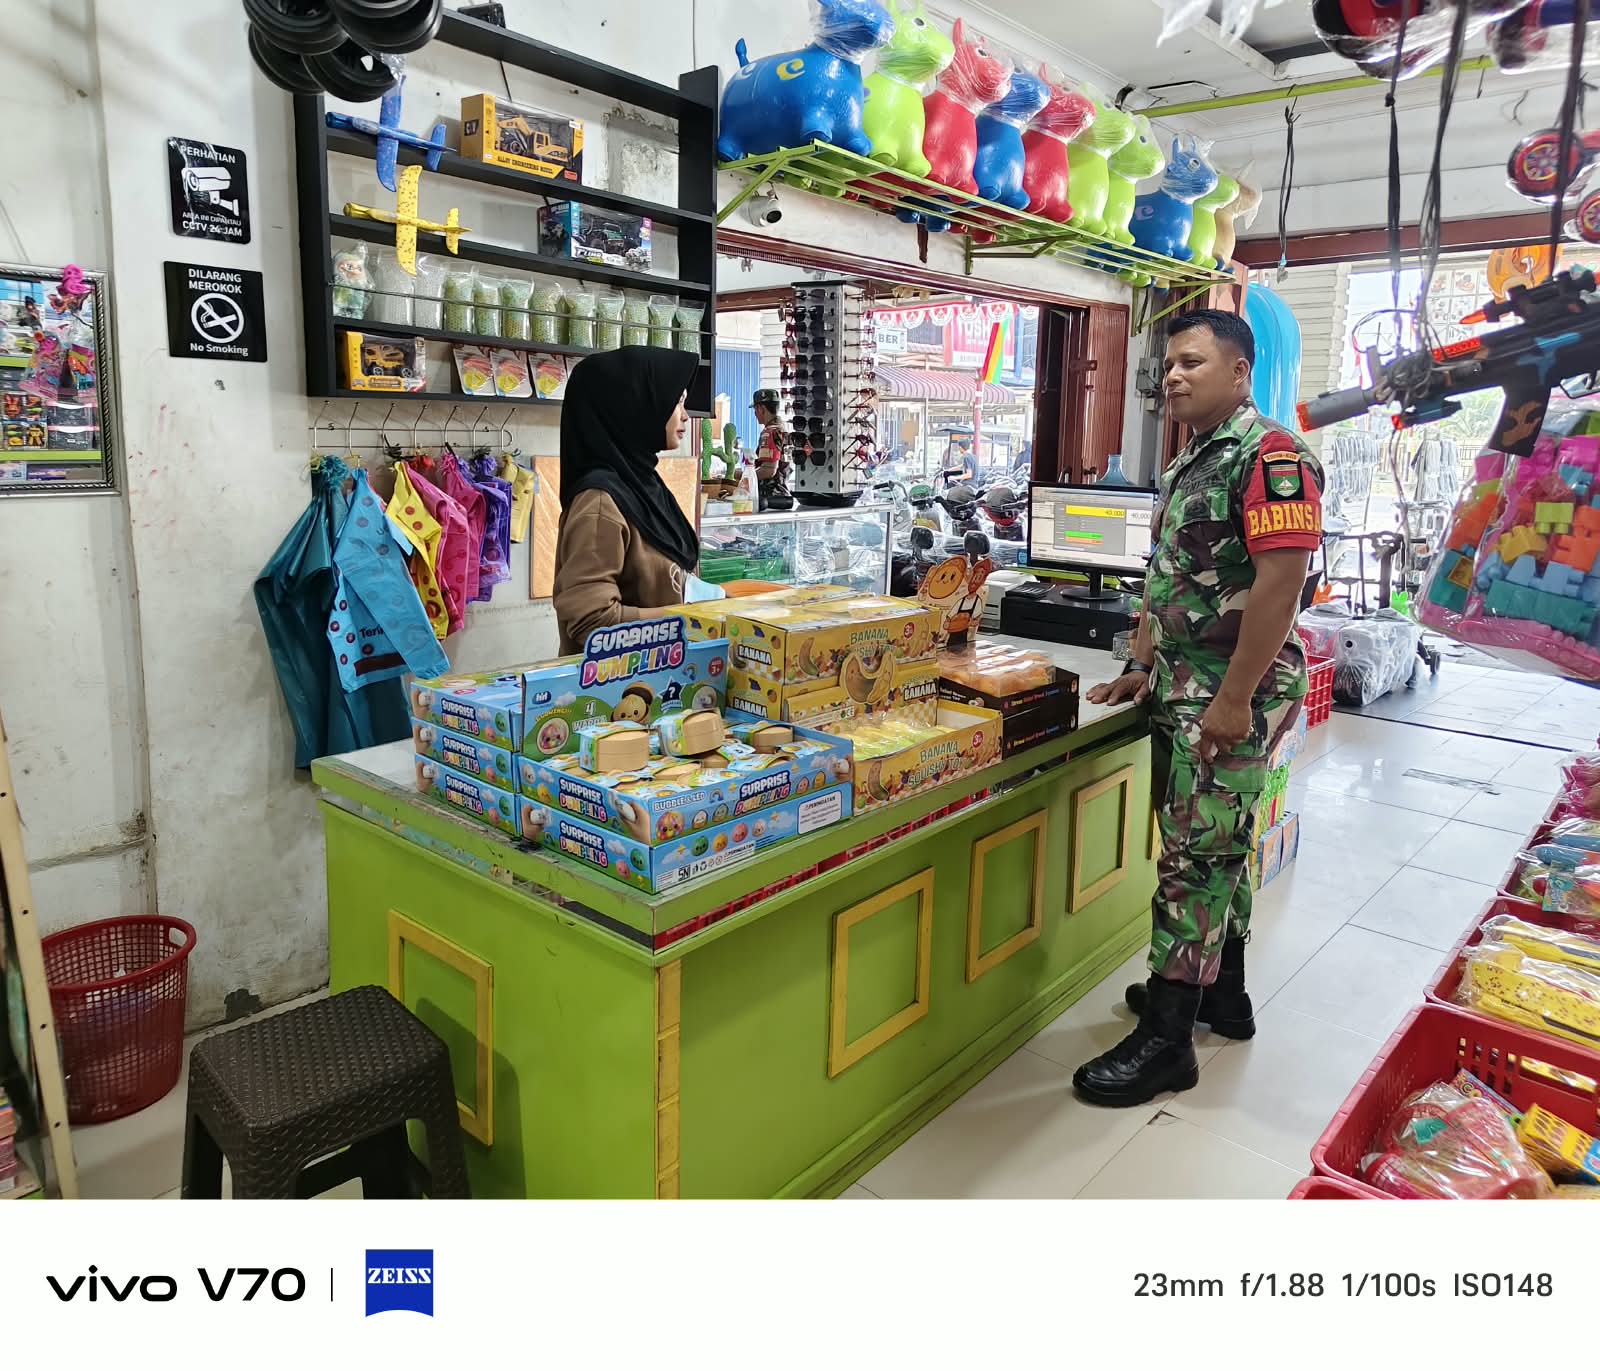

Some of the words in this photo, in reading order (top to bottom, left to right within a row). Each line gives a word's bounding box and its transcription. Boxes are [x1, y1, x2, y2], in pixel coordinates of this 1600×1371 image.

[180, 145, 236, 164] PERHATIAN
[182, 221, 207, 232] CCTV
[209, 224, 221, 233] 24
[222, 226, 243, 237] JAM
[188, 268, 242, 283] DILARANG
[188, 280, 242, 294] MEROKOK
[190, 342, 204, 352] No
[206, 343, 249, 357] Smoking
[1247, 502, 1321, 536] BABINSA
[590, 620, 681, 654] SURPRISE
[851, 628, 889, 645] BANANA
[581, 641, 684, 687] DUMPLING
[738, 645, 772, 665] BANANA
[904, 682, 937, 700] BANANA
[441, 699, 474, 718] SURPRISE
[734, 698, 768, 718] BANANA
[443, 737, 476, 758] SURPRISE
[920, 741, 958, 763] BANANA
[446, 775, 479, 798] SURPRISE
[560, 778, 603, 804] SURPRISE
[740, 771, 789, 798] SURPRISE
[559, 793, 607, 822] DUMPLING
[653, 796, 684, 812] BUBBLE
[694, 791, 706, 801] LED
[735, 783, 790, 816] DUMPLING
[560, 822, 603, 849] SURPRISE
[560, 836, 608, 867] DUMPLING
